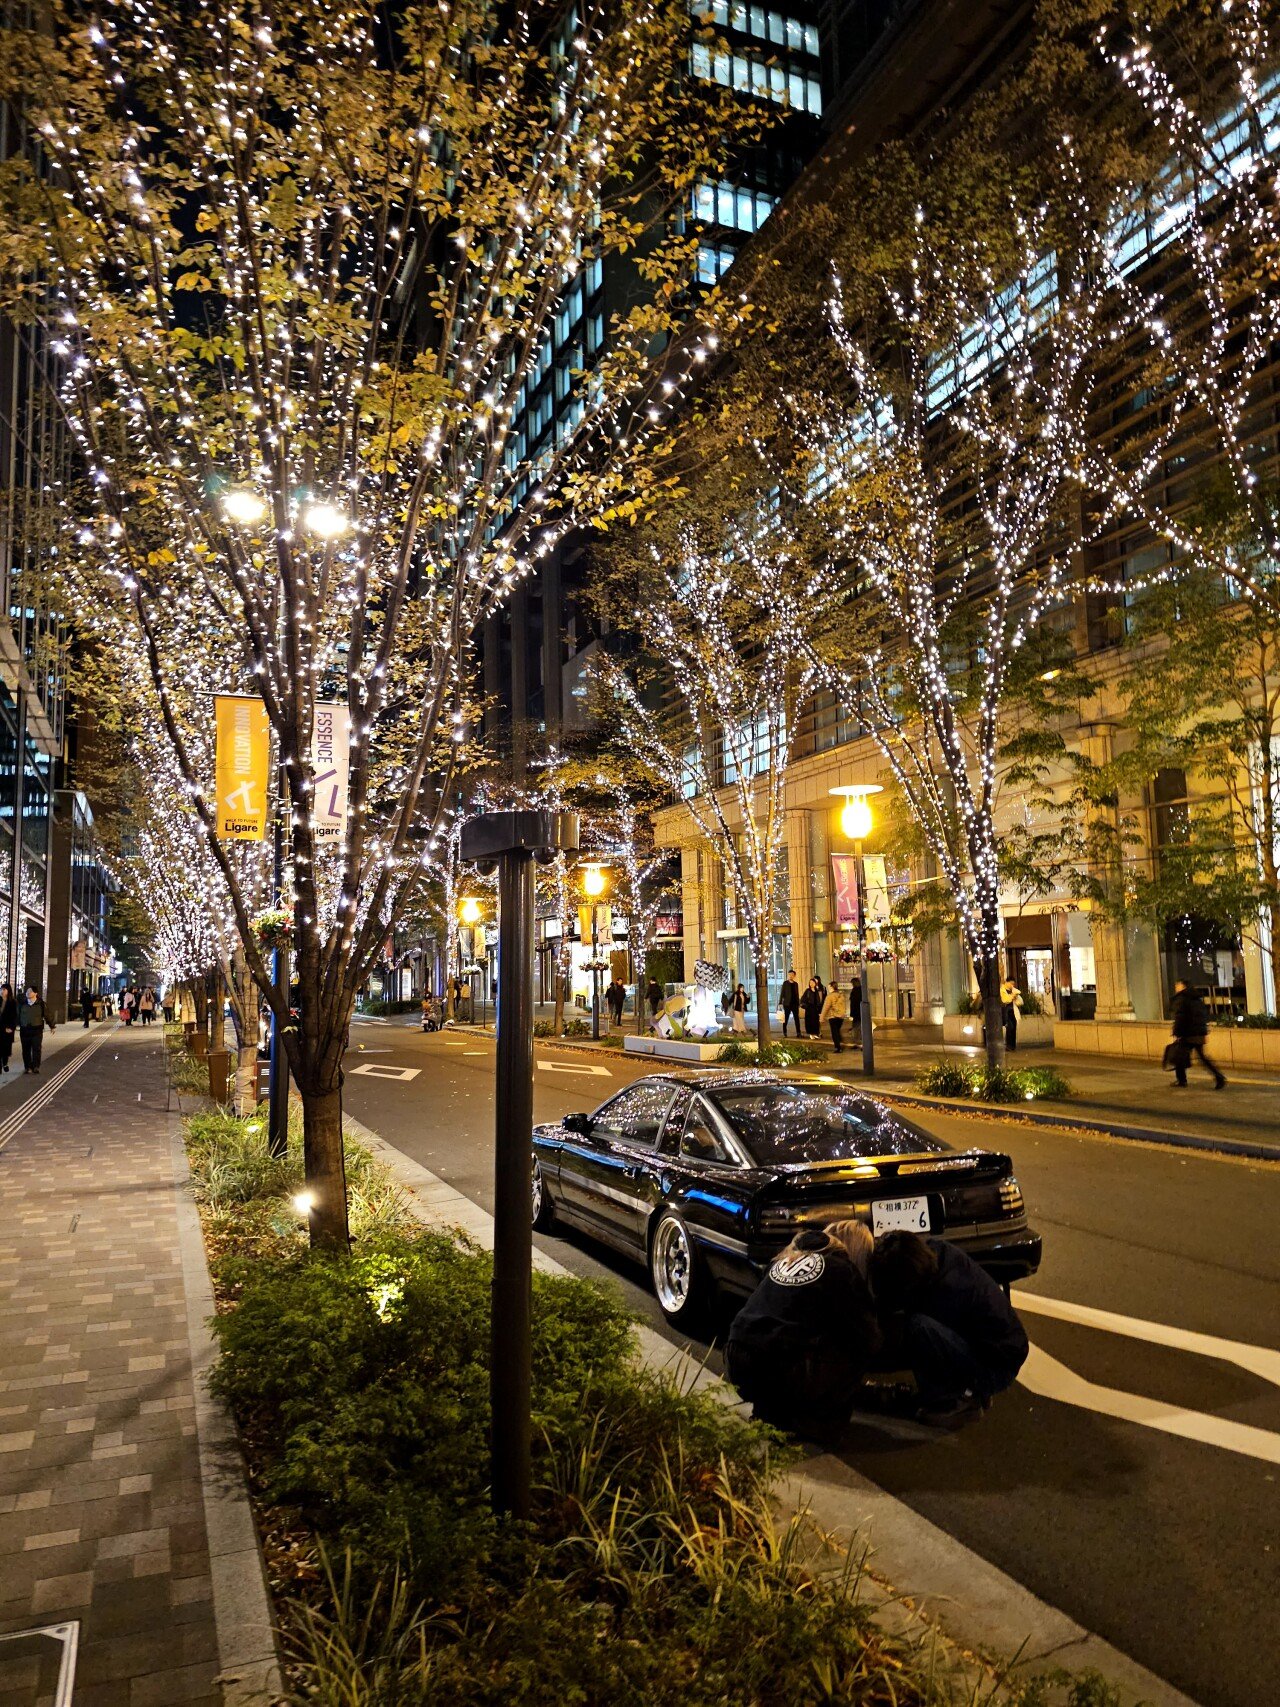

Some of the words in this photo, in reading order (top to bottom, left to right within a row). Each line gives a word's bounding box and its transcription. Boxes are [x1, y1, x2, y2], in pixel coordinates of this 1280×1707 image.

[234, 705, 251, 774] INNOVATION
[317, 711, 332, 763] ESSENCE
[225, 822, 258, 834] Ligare
[315, 826, 341, 837] igare
